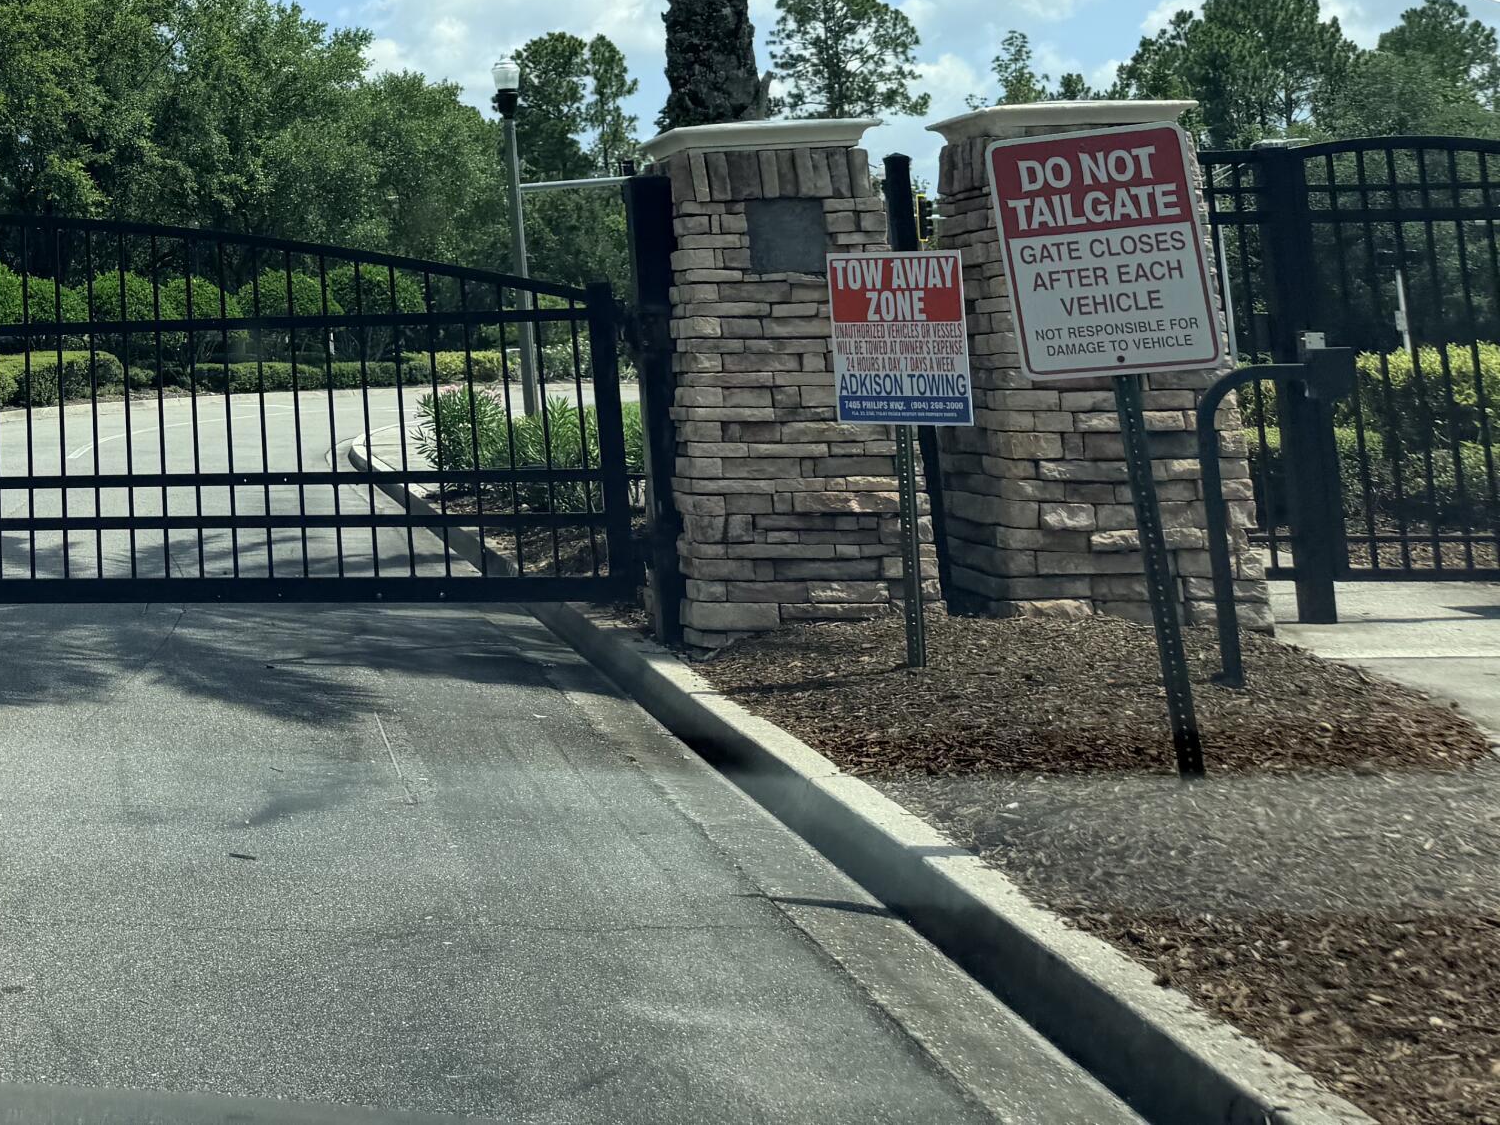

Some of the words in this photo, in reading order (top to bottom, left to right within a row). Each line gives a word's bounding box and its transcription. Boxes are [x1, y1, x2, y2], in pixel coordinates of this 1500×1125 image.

[1017, 157, 1071, 192] DO
[1077, 146, 1155, 185] NOT
[1006, 183, 1181, 231] TAILGATE
[1020, 240, 1082, 264] GATE
[1089, 231, 1185, 258] CLOSES
[833, 260, 883, 290] TOW
[892, 258, 955, 289] AWAY
[1033, 266, 1108, 291] AFTER
[1119, 259, 1183, 284] EACH
[866, 290, 926, 321] ZONE
[1060, 289, 1163, 316] VEHICLE
[835, 324, 885, 339] UNAUTHORIZED
[887, 324, 919, 338] VEHICLES
[921, 324, 931, 338] OR
[933, 323, 962, 338] VESSELS
[1035, 328, 1063, 341] NOT
[1068, 320, 1165, 339] RESPONSIBLE
[1170, 317, 1199, 330] FOR
[837, 341, 852, 355] WILL
[855, 341, 863, 355] BE
[864, 341, 888, 355] TOWED
[890, 341, 897, 355] AT
[900, 340, 930, 355] OWNER'S
[933, 340, 963, 355] EXPENSE
[1047, 338, 1106, 356] DAMAGE
[1109, 339, 1128, 351] TO
[1134, 334, 1193, 349] VEHICLE
[846, 357, 854, 371] 24
[857, 357, 880, 371] HOURS
[882, 357, 886, 371] A
[889, 357, 902, 372] DAY,
[904, 357, 908, 371] 7
[910, 357, 927, 371] DAYS
[930, 357, 933, 371] A
[936, 357, 955, 371] WEEK
[840, 374, 904, 395] ADKISON
[908, 374, 966, 395] TOWING
[845, 401, 860, 409] 7405
[862, 401, 887, 409] PHILIPS
[911, 402, 928, 410] (904)
